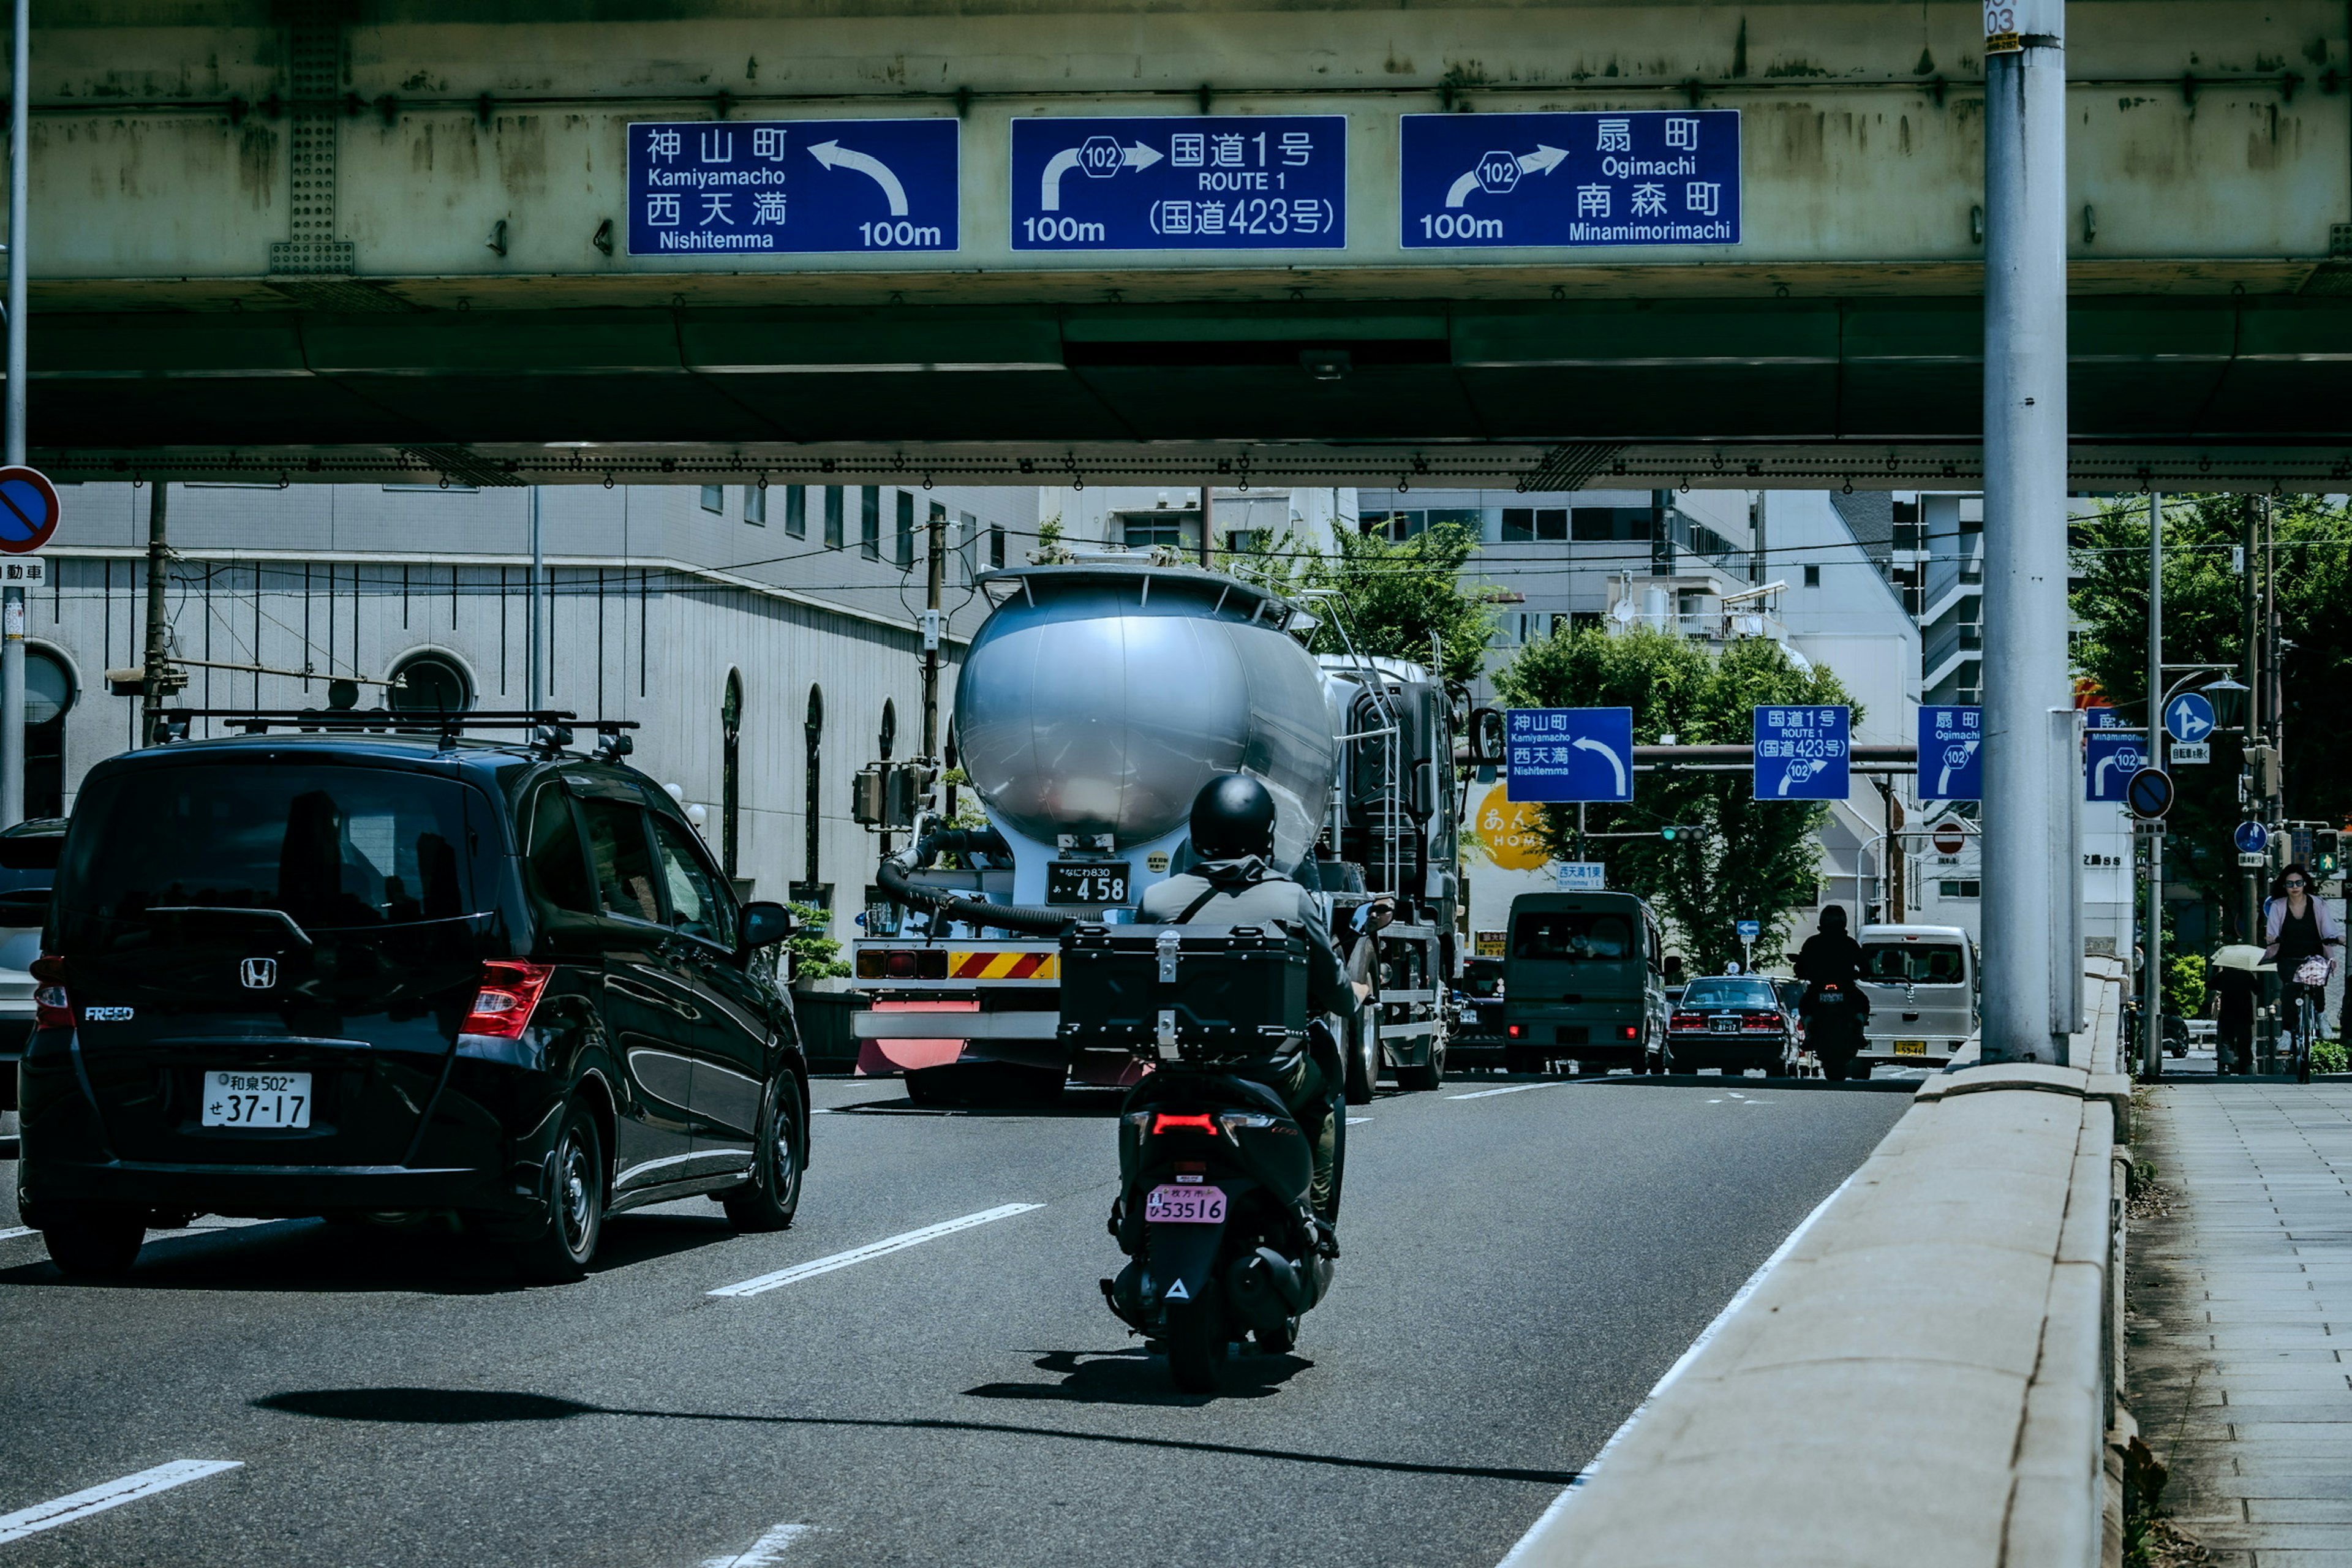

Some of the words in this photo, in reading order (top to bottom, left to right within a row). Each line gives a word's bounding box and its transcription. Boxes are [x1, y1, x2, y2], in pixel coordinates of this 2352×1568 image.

[1596, 118, 1700, 152] 扇町
[647, 129, 786, 164] 神山町
[1171, 132, 1313, 167] 国道1号
[1086, 146, 1117, 168] 102
[1483, 163, 1513, 183] 102
[1602, 156, 1695, 179] Ogimachi
[648, 168, 785, 189] Kamiyamacho
[1199, 172, 1268, 190] ROUTE
[1277, 172, 1284, 189] 1
[647, 192, 786, 225] 西天満
[1577, 182, 1721, 218] 南森町
[1150, 198, 1333, 235] (国道423号)
[859, 222, 941, 246] 100m
[1023, 217, 1105, 241] 100m
[1420, 214, 1503, 239] 100m
[1569, 221, 1730, 241] Minamimorimachi
[660, 230, 773, 249] Nishitemma
[0, 565, 42, 579] 動車
[1513, 714, 1567, 731] 神山町
[1768, 710, 1836, 728] 国道1号
[1511, 733, 1570, 744] Kamiyamacho
[1782, 729, 1814, 737] ROUTE
[1818, 729, 1823, 737] 1
[1936, 730, 1980, 741] Ogimachi
[1514, 747, 1568, 764] 西天満
[1758, 739, 1845, 757] (国道423号)
[1947, 752, 1964, 763] 102
[2117, 754, 2135, 766] 102
[1513, 766, 1569, 775] Nishitemma
[1790, 766, 1807, 777] 102
[1065, 869, 1110, 877] なにわ830
[85, 1007, 134, 1020] FREED
[209, 1102, 223, 1115] せ
[227, 1095, 304, 1123] 37-17
[1162, 1199, 1221, 1218] 53516
